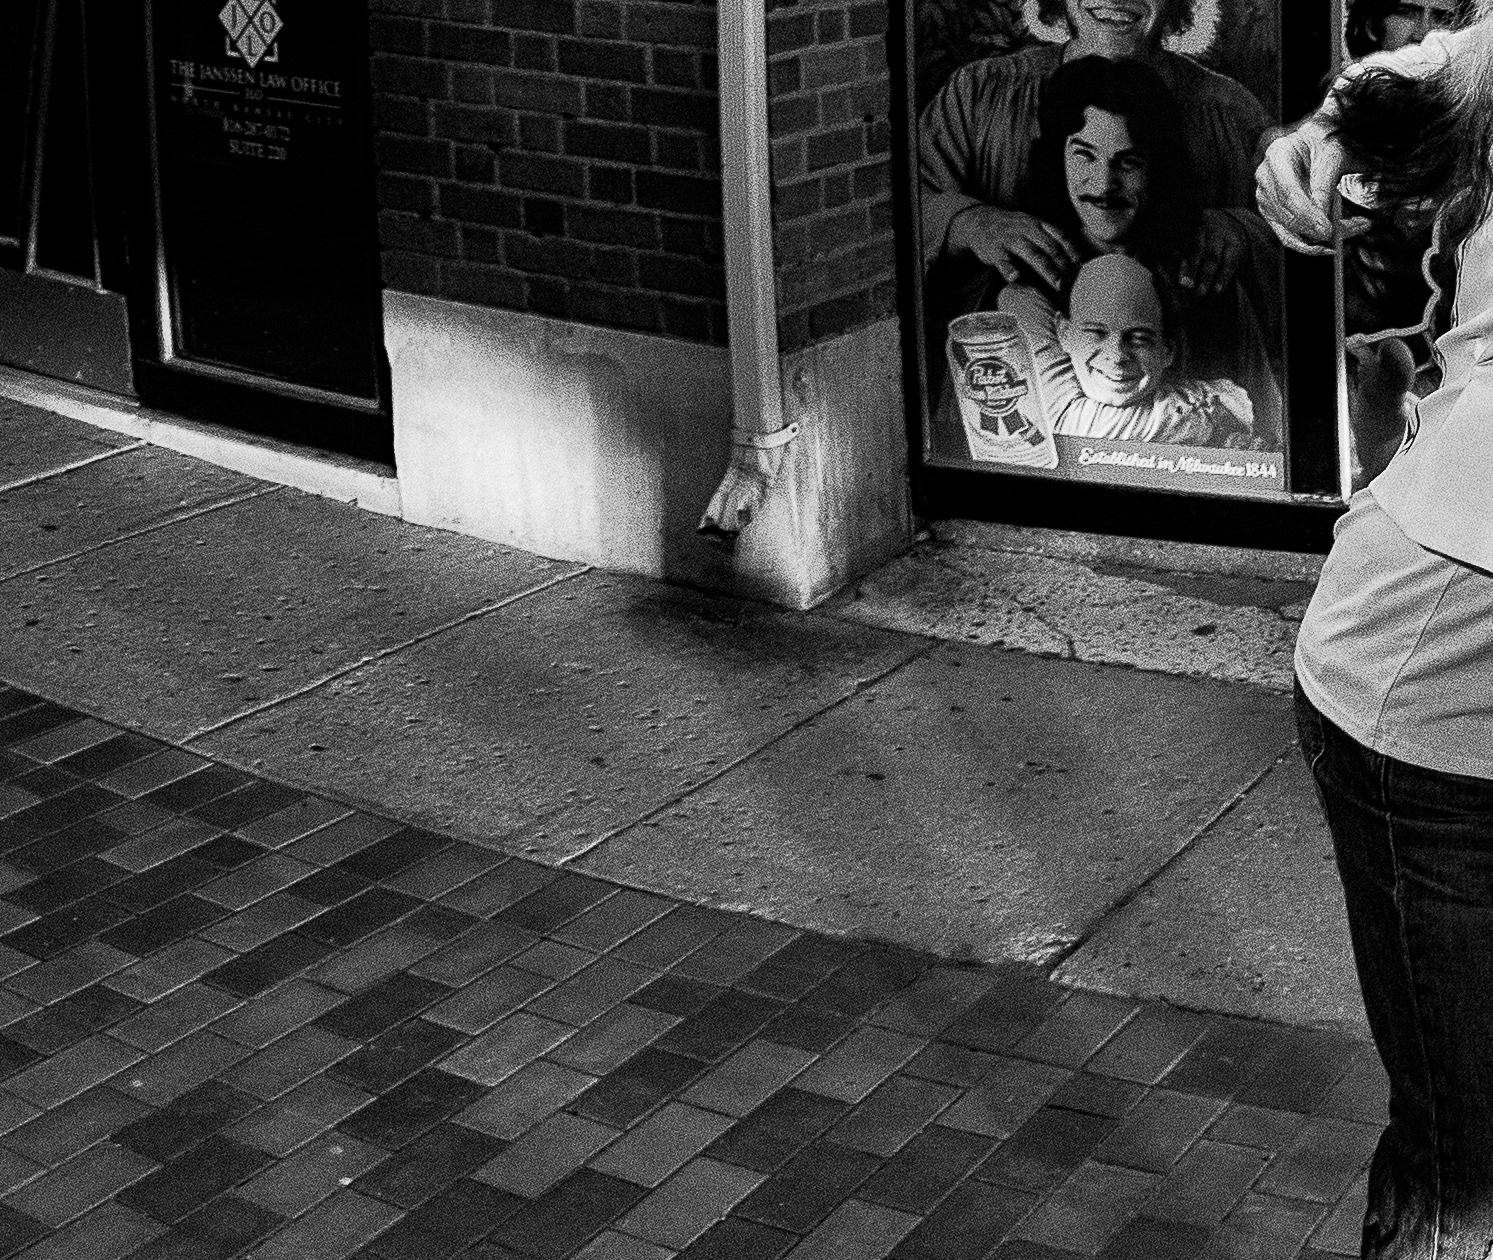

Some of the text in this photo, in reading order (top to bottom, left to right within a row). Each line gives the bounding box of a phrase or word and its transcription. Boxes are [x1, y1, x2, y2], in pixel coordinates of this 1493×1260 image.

[169, 58, 341, 98] THE JANSSEN LAW OFFICE
[1078, 447, 1277, 478] Established in Milwaukee 1844
